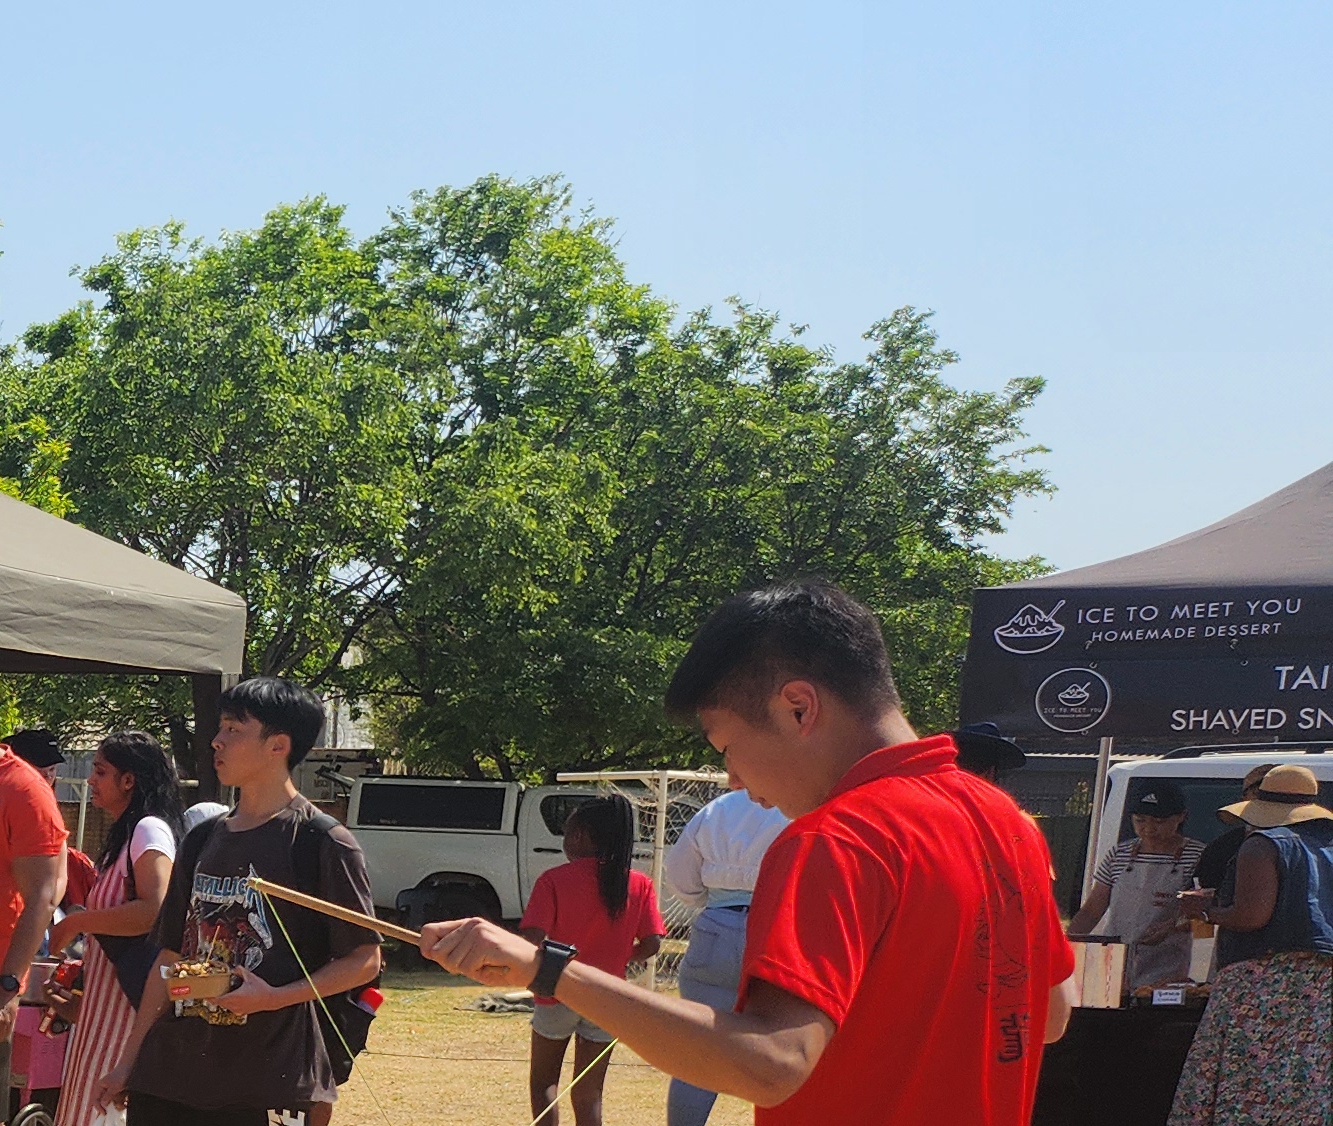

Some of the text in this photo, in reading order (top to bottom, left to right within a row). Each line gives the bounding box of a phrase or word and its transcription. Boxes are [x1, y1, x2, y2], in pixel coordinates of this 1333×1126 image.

[1077, 598, 1302, 624] ICE TO MEET YOU
[1091, 622, 1282, 642] HOMEMADE DESSERT
[1274, 665, 1333, 690] TAI
[1170, 708, 1287, 731] SHAVED
